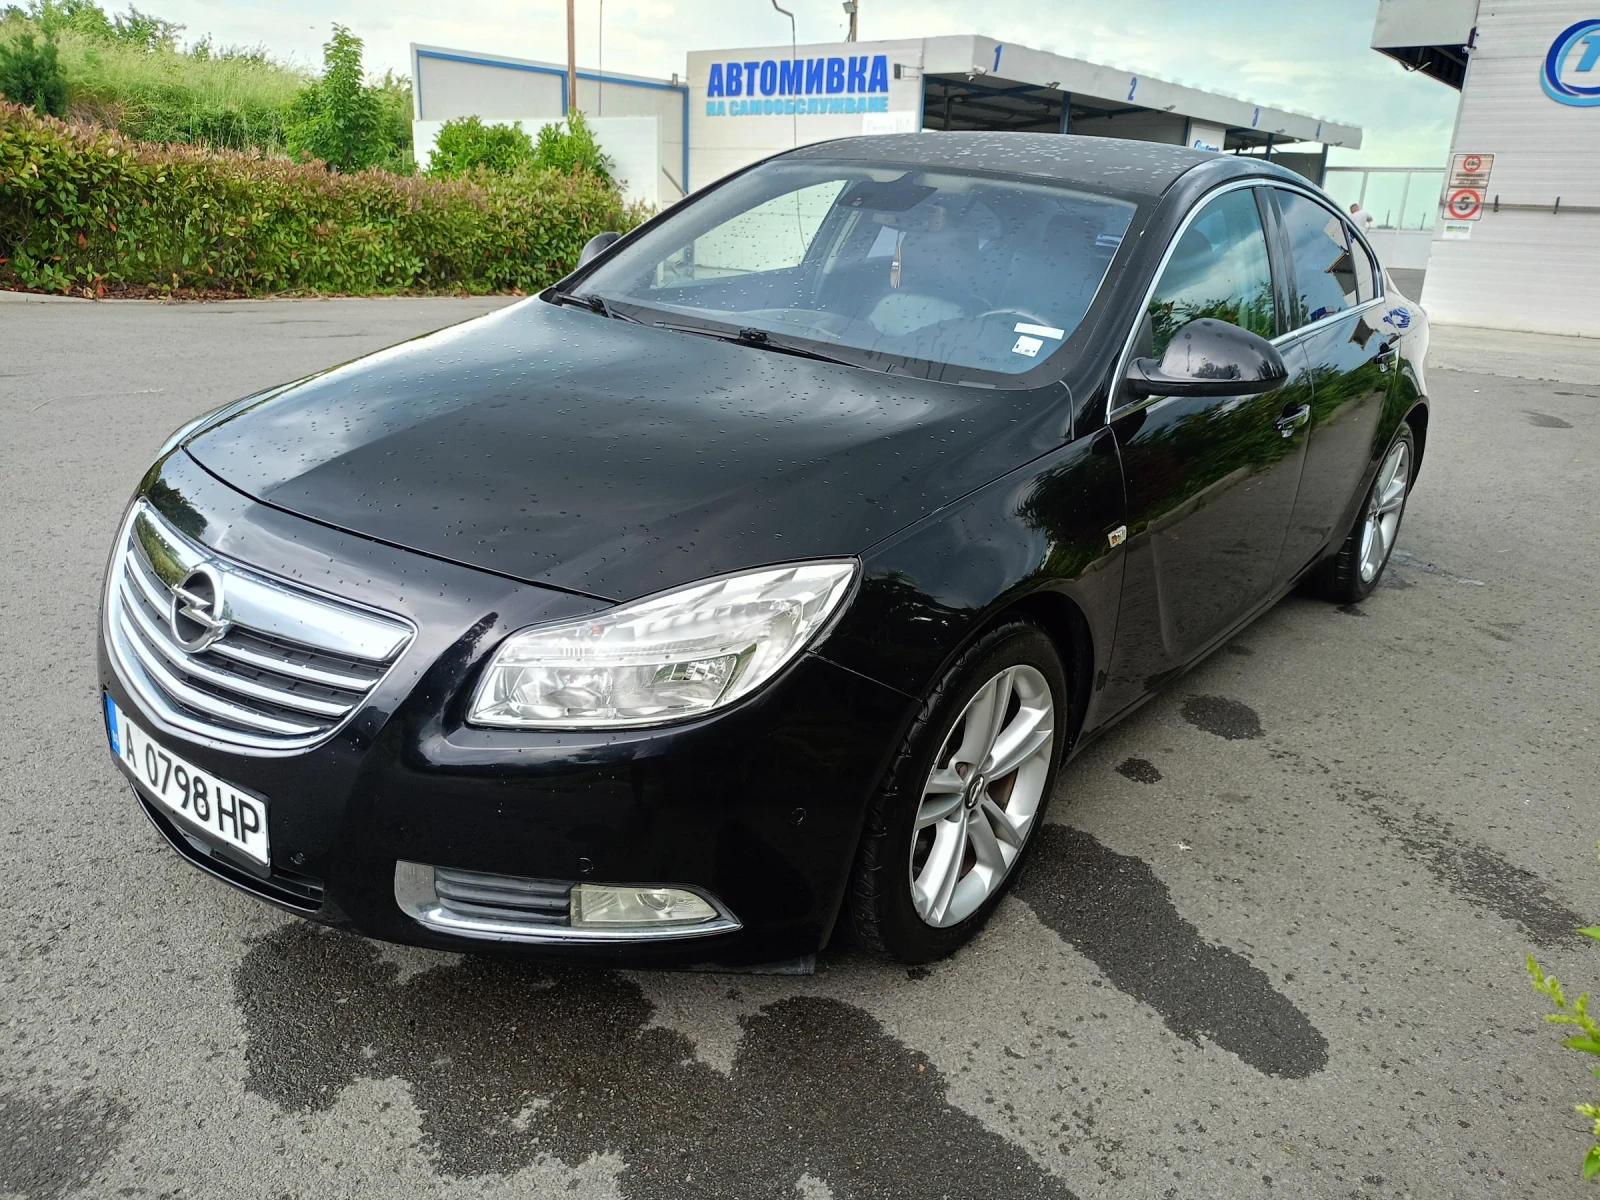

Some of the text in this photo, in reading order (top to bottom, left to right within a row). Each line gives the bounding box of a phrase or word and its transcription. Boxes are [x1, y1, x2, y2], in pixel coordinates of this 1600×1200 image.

[993, 44, 1003, 73] 1
[706, 55, 889, 98] АВТОМИВКА
[1127, 77, 1138, 101] 2
[706, 96, 889, 117] НА САМООБСЛУЖВАНЕ
[1459, 196, 1470, 211] 5
